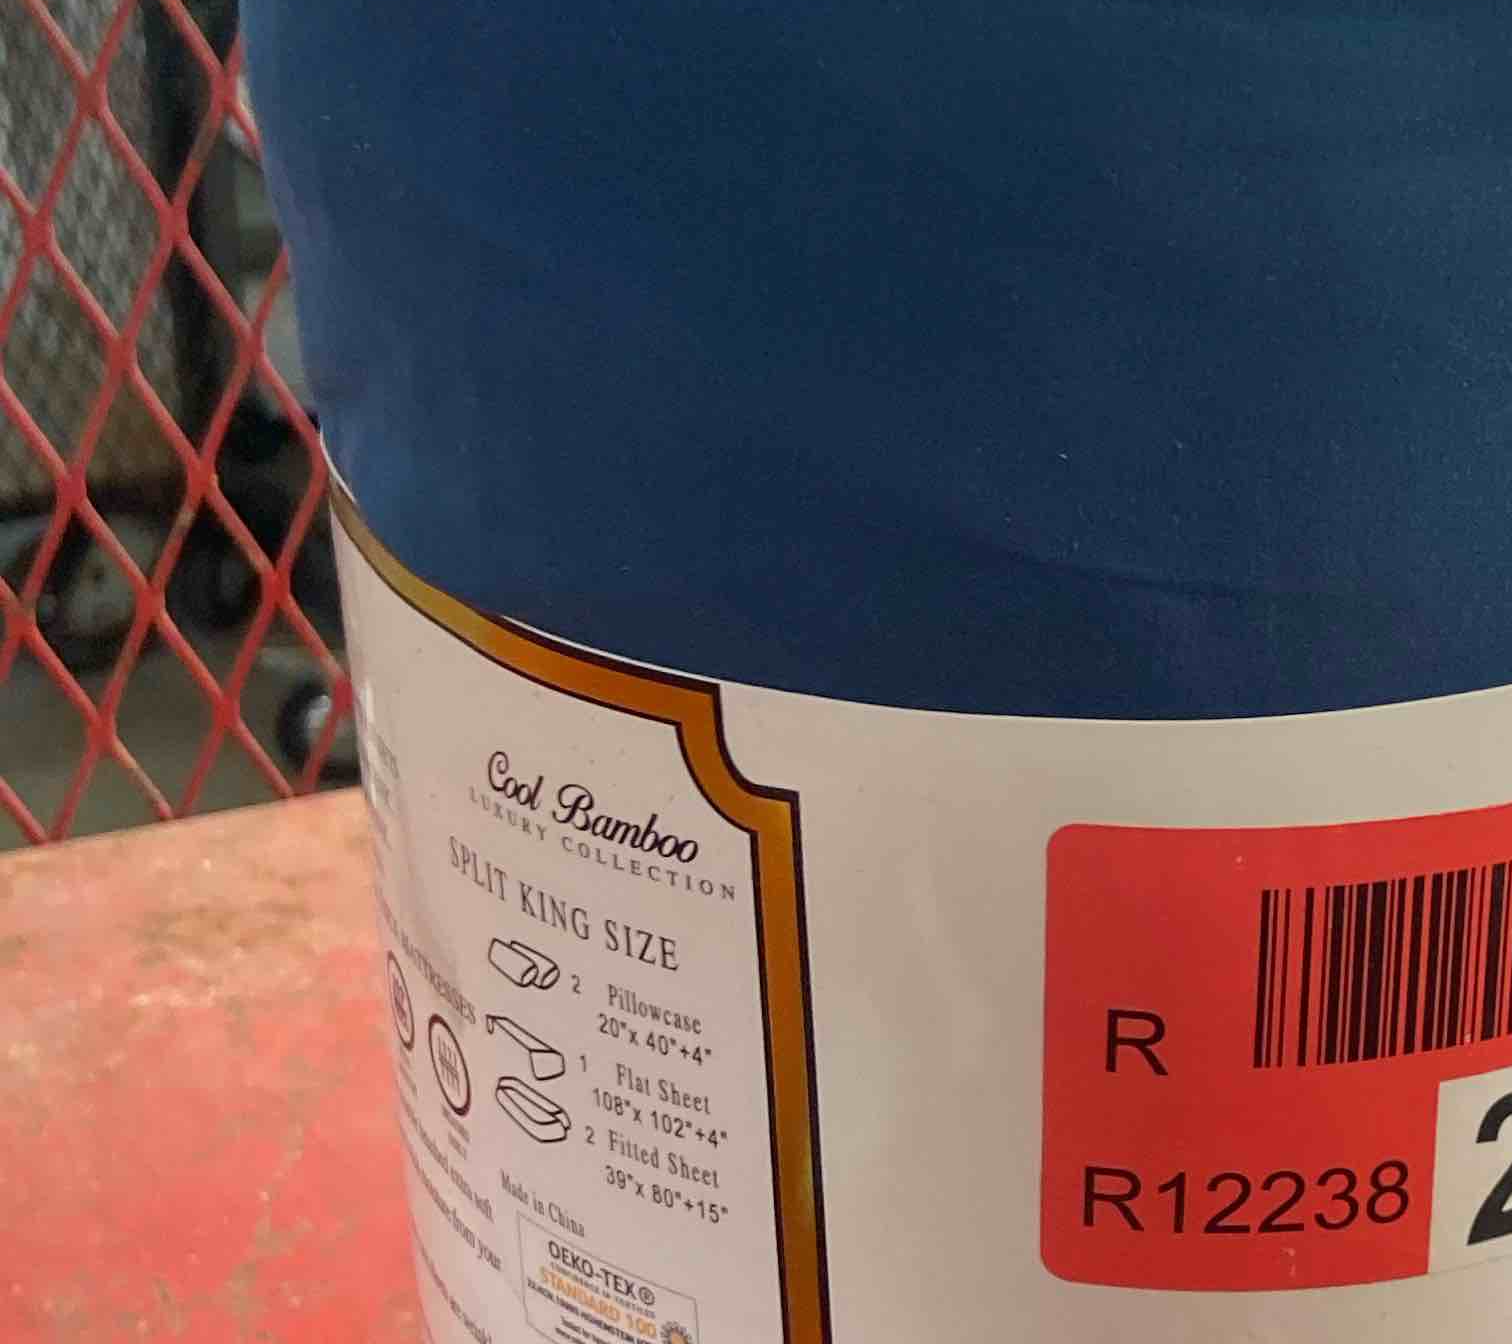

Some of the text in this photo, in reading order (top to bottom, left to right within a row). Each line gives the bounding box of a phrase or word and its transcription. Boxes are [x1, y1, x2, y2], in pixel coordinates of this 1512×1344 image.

[487, 751, 699, 864] Cool Bamboo
[469, 786, 737, 902] LUXURY COLLECTION
[449, 835, 680, 971] SPLIT KING SIZE
[571, 974, 702, 1035] 2 Pillowcase
[1104, 1008, 1169, 1077] R
[616, 1063, 651, 1097] Flat
[658, 1079, 711, 1115] Sheet
[585, 1125, 595, 1145] 2
[668, 1152, 719, 1189] Sheet
[549, 1202, 586, 1238] China
[1081, 1159, 1411, 1235] R12238
